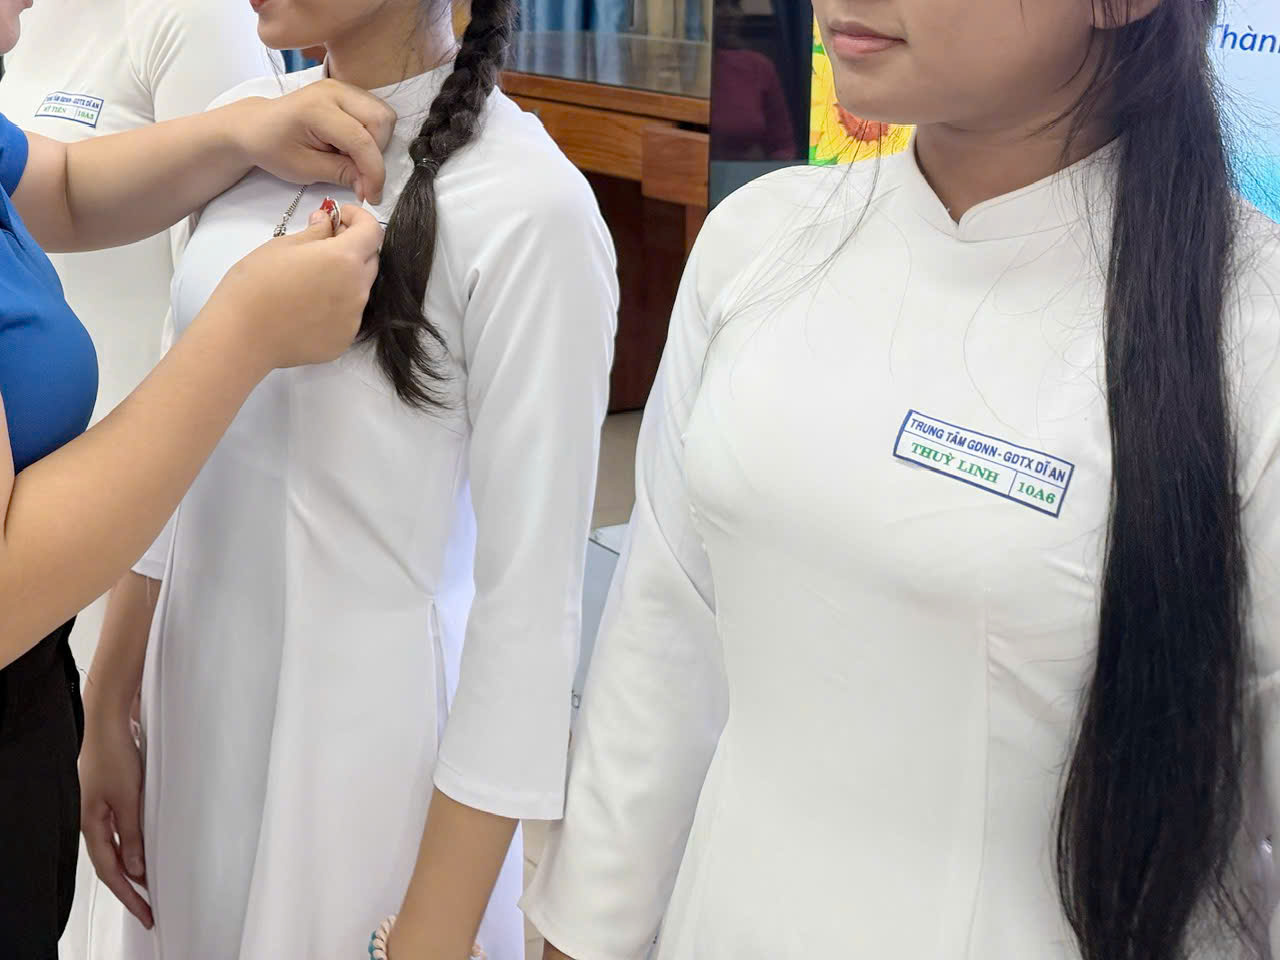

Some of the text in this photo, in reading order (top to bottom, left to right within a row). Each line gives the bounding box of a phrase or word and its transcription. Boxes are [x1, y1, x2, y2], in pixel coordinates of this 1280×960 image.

[911, 418, 945, 440] TRUNG
[945, 431, 967, 448] TÂM
[967, 439, 999, 457] GDNN
[1003, 451, 1035, 470] GDTX
[1035, 460, 1051, 476] DĨ
[1049, 467, 1067, 483] AN
[957, 460, 1000, 484] LINH
[1017, 482, 1057, 505] 10A6
